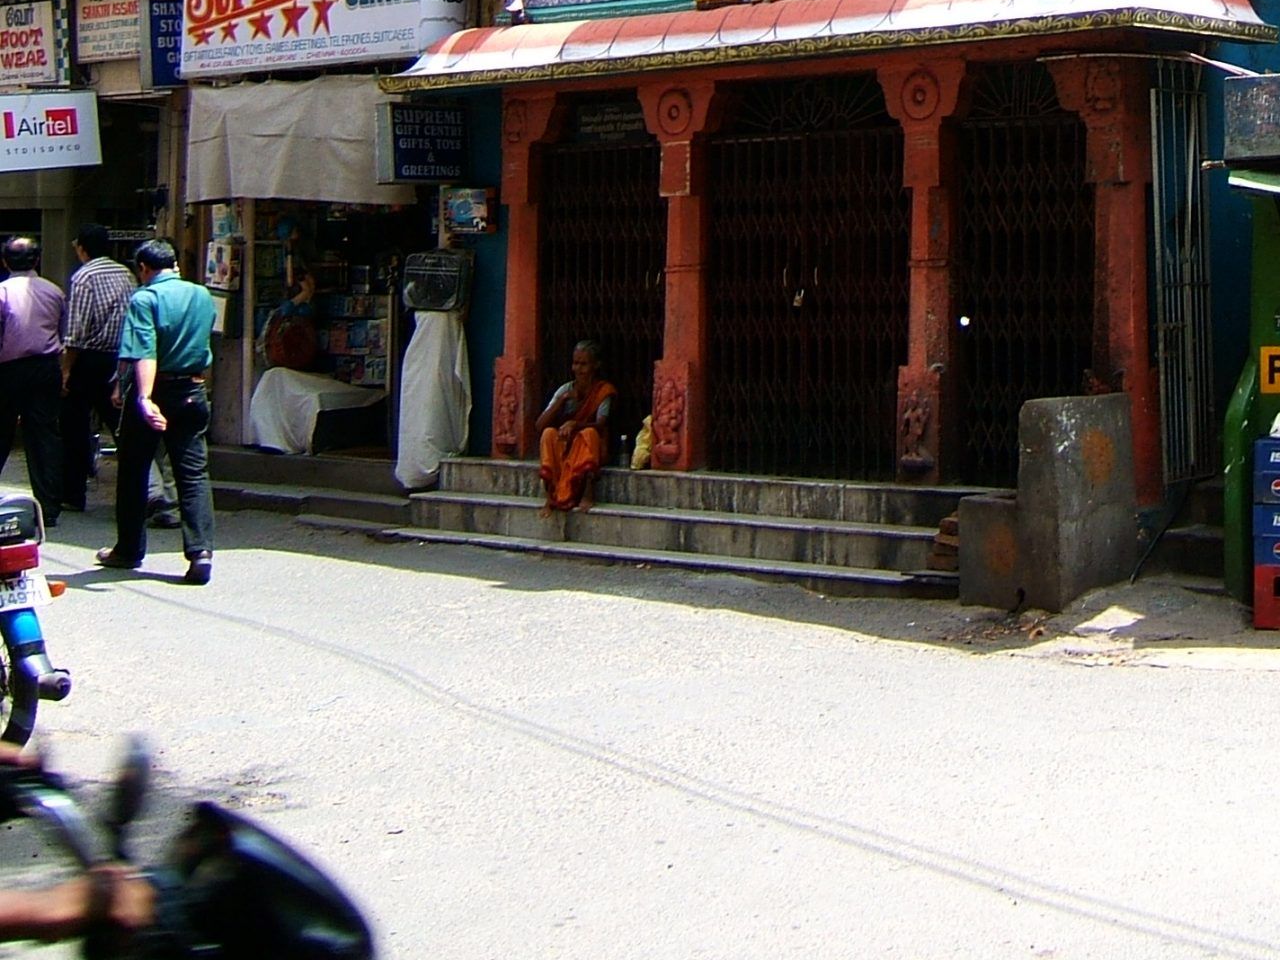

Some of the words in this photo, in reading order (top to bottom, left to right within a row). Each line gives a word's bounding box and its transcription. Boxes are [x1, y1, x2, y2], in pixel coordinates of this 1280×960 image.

[1, 49, 48, 70] WEAR
[395, 109, 464, 125] SUPREME
[17, 115, 72, 137] Airtel
[395, 124, 420, 136] GIFT
[424, 124, 464, 136] CENTRE
[399, 137, 434, 150] GIFTS,
[437, 138, 462, 150] TOYS
[401, 164, 461, 177] GREETINGS
